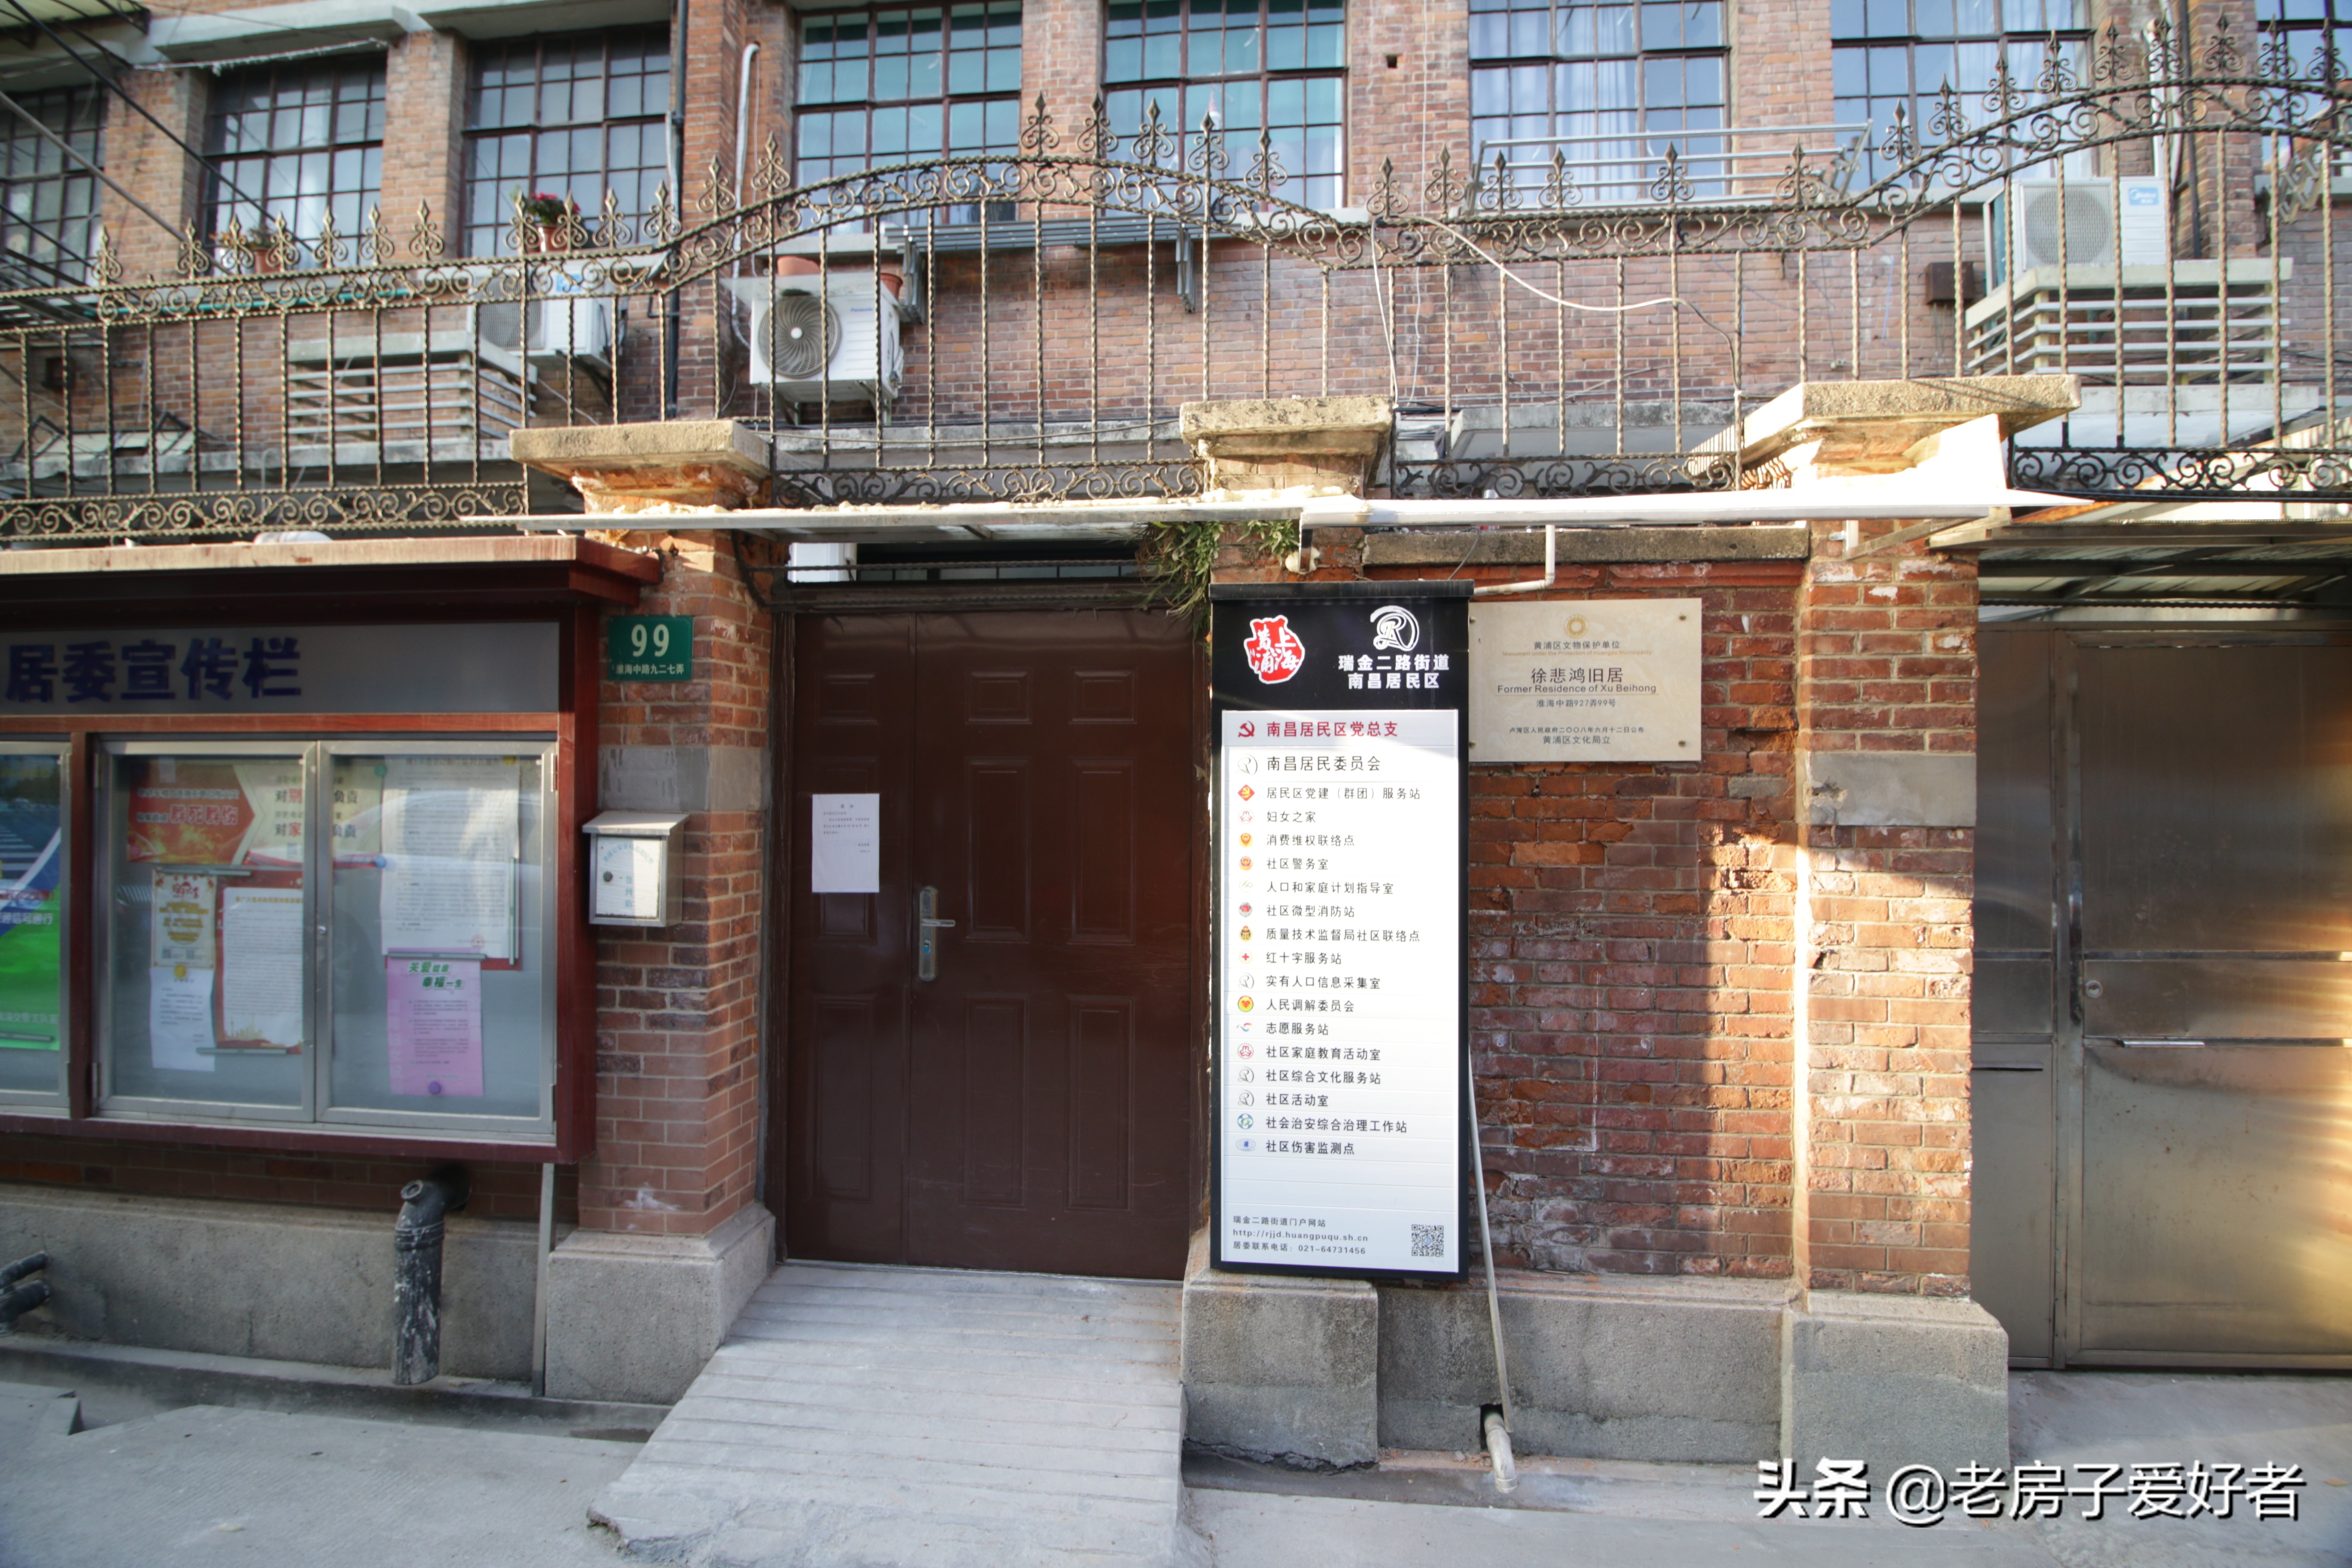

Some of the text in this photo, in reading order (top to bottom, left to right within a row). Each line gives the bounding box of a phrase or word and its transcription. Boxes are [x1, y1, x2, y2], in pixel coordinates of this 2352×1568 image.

[631, 624, 670, 657] 99
[1534, 641, 1619, 649] 黄浦区文物保护单位
[616, 664, 684, 674] 淮海中路九二七弄
[1338, 654, 1449, 671] 瑞金二路街道
[4, 638, 302, 702] 居委宣传栏
[1531, 668, 1623, 683] 徐悲鸿旧居
[1348, 673, 1439, 689] 南昌居民区
[1498, 685, 1533, 693] Former
[1535, 684, 1586, 693] Residence
[1616, 684, 1656, 693] Beihong
[1537, 699, 1614, 707] 淮海中路927弄99号
[1267, 722, 1397, 737] 南昌居民区党总支
[1544, 736, 1609, 744] 黄浦区文化局立
[1268, 756, 1380, 771] 南昌居民委员会
[1267, 812, 1315, 822] 妇女之家
[1267, 834, 1354, 846] 消费维权联络点
[1267, 858, 1328, 870] 社区警务室
[1268, 882, 1393, 894] 人口和家庭计划指导室
[1267, 905, 1354, 917] 社区微型消防站
[1267, 928, 1419, 942] 质量技术监督局社区联络点
[1267, 952, 1341, 964] 红十字服务站
[1267, 975, 1380, 989] 实有人口信息采集室
[1267, 999, 1354, 1012] 人民调解委员会
[1267, 1023, 1328, 1035] 志愿服务站
[1267, 1046, 1380, 1060] 社区家庭教育活动室
[1266, 1070, 1380, 1084] 社区综合文化服务站
[1266, 1093, 1328, 1106] 社区活动室
[1266, 1117, 1406, 1133] 社会治安综合治理工作站
[1266, 1140, 1354, 1154] 社区伤害监测点
[1234, 1216, 1325, 1227] 瑞金二路街道门户网站
[1233, 1229, 1368, 1242] http://rjjd.huangpuqu.sh.cn
[1298, 1245, 1365, 1254] 021-64731456
